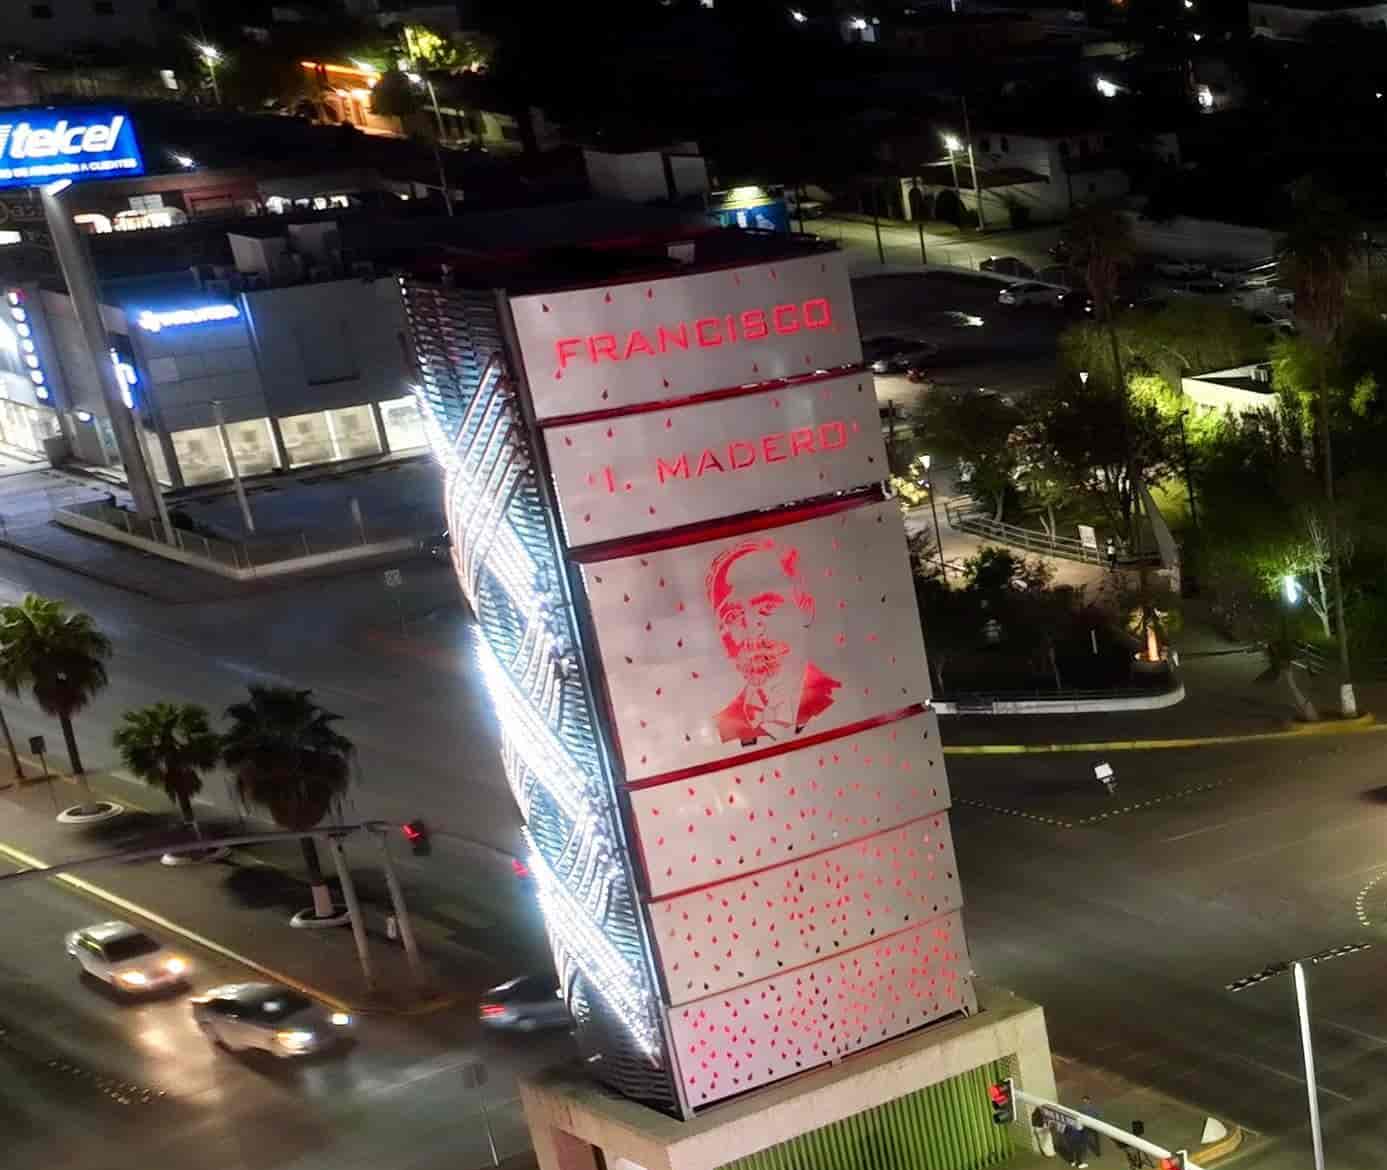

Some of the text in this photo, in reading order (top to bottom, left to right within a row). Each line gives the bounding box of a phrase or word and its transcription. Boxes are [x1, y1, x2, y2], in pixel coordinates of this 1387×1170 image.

[9, 115, 124, 159] telcel
[555, 298, 832, 368] FRANCISCO
[656, 421, 847, 485] MADERO
